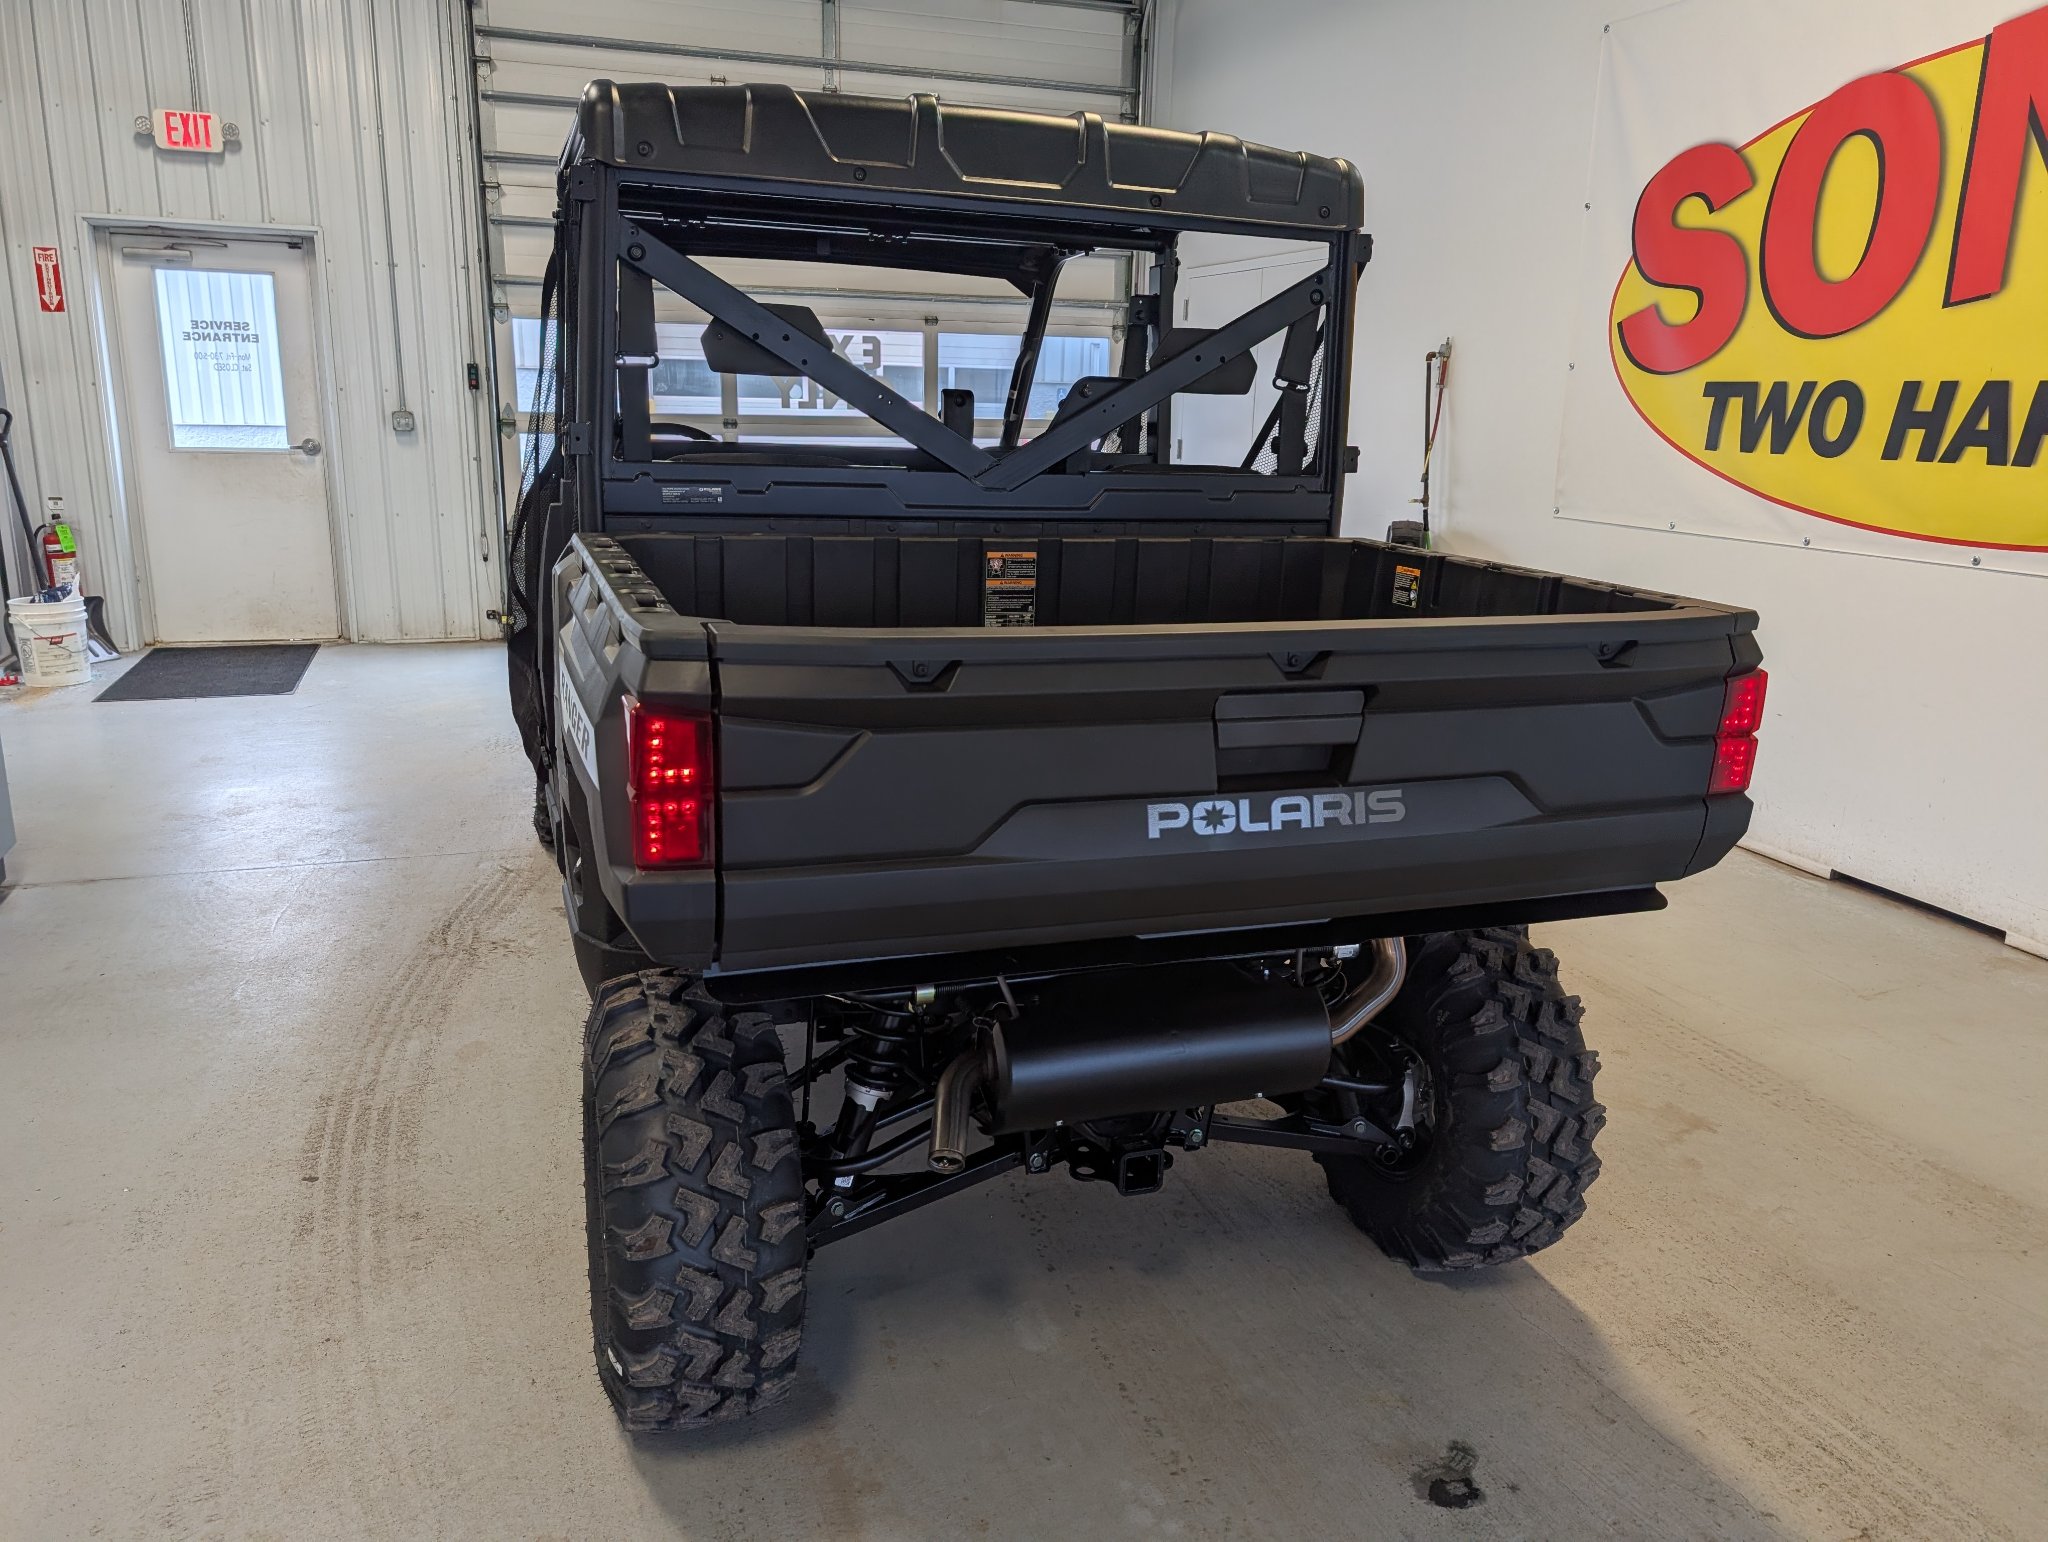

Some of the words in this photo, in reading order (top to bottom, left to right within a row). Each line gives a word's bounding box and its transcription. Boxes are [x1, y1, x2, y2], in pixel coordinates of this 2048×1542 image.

[165, 112, 212, 149] EXIT
[38, 253, 54, 262] FIRE
[1702, 379, 1864, 459] TWO
[1147, 788, 1406, 839] POLARIS
